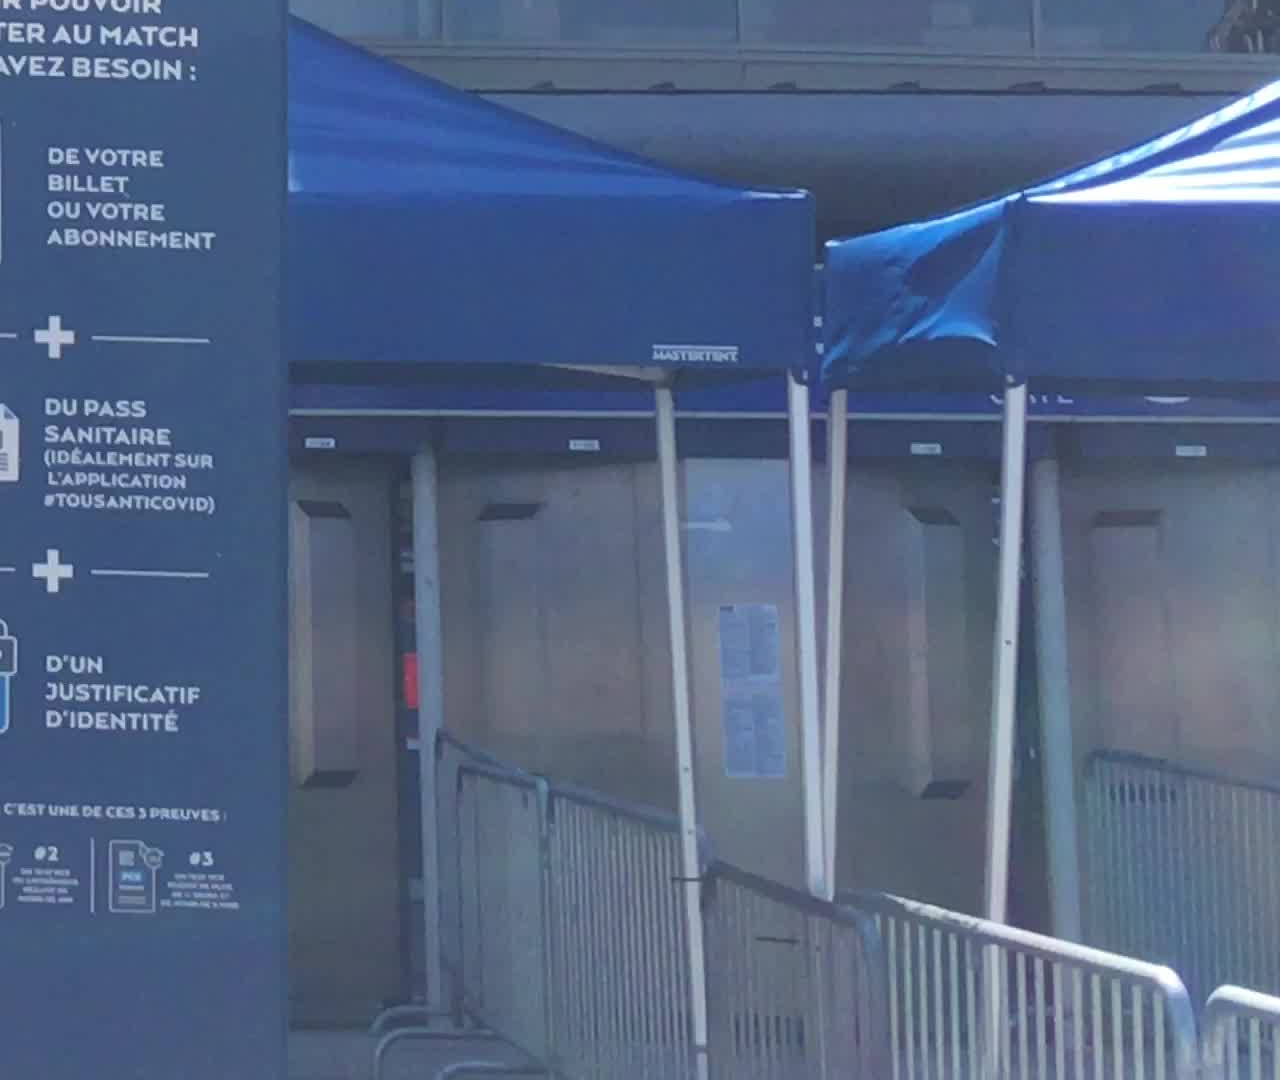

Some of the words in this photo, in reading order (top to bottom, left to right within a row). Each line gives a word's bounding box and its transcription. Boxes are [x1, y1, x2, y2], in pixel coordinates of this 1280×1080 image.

[52, 24, 91, 45] AU
[100, 26, 198, 48] MATCH
[48, 147, 79, 165] DE
[85, 149, 164, 168] VOTRE
[48, 174, 129, 193] BILLET
[47, 201, 80, 220] OU
[86, 203, 165, 222] VOTRE
[47, 229, 216, 250] ABONNEMENT
[652, 350, 738, 362] MASTERTENT
[45, 399, 77, 417] DU
[84, 400, 146, 418] PASS
[44, 425, 171, 446] SANITAIRE
[175, 454, 213, 469] SUR
[48, 472, 187, 489] L'APPLICATION
[45, 655, 103, 674] D'UN
[45, 683, 200, 705] JUSTIFICATIF
[48, 804, 80, 818] UNE
[82, 805, 103, 818] DE
[106, 806, 136, 819] CES
[149, 807, 221, 822] PREUVES
